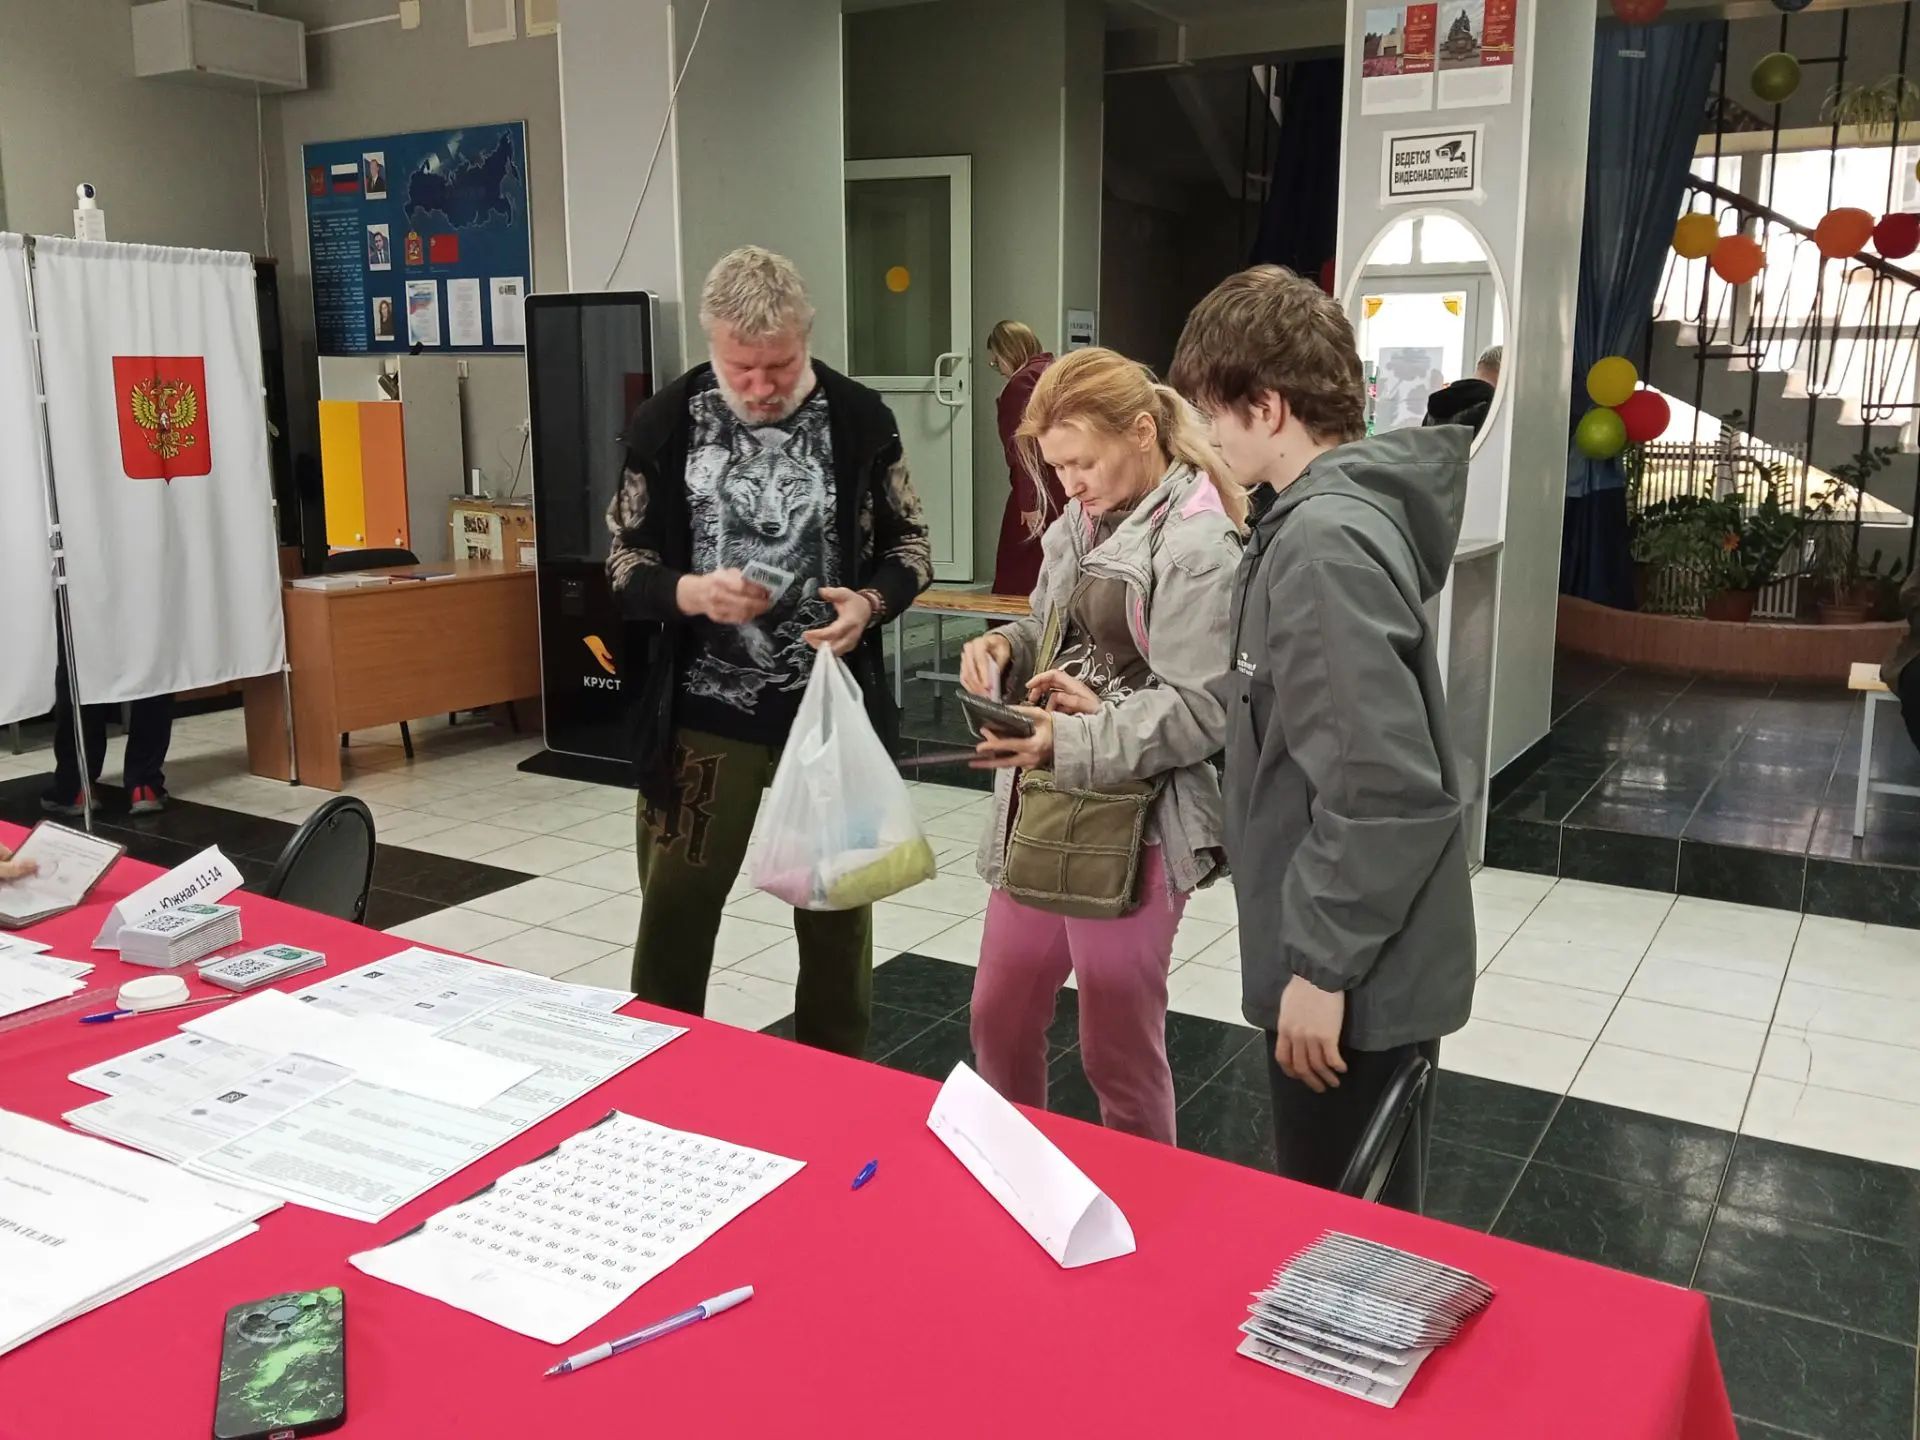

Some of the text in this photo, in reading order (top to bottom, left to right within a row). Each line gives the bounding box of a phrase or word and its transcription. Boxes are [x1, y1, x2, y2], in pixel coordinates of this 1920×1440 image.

[1394, 166, 1469, 185] ВИДЕОНАБЛЮДЕНИЕ
[1395, 150, 1430, 168] ВЕДЕТСЯ
[583, 675, 621, 691] КРУСТ
[160, 866, 223, 910] Южная 11-14
[480, 1200, 656, 1258] 71 72 73 74 75 76 77 78 79 80
[499, 1188, 675, 1243] 61 62 63 64 65 66 67 68 69 70
[435, 1224, 622, 1289] 91 92 93 94 95 96 97 98 99 100
[457, 1212, 636, 1272] 81 82 83 84 85 86 87 88 89 90
